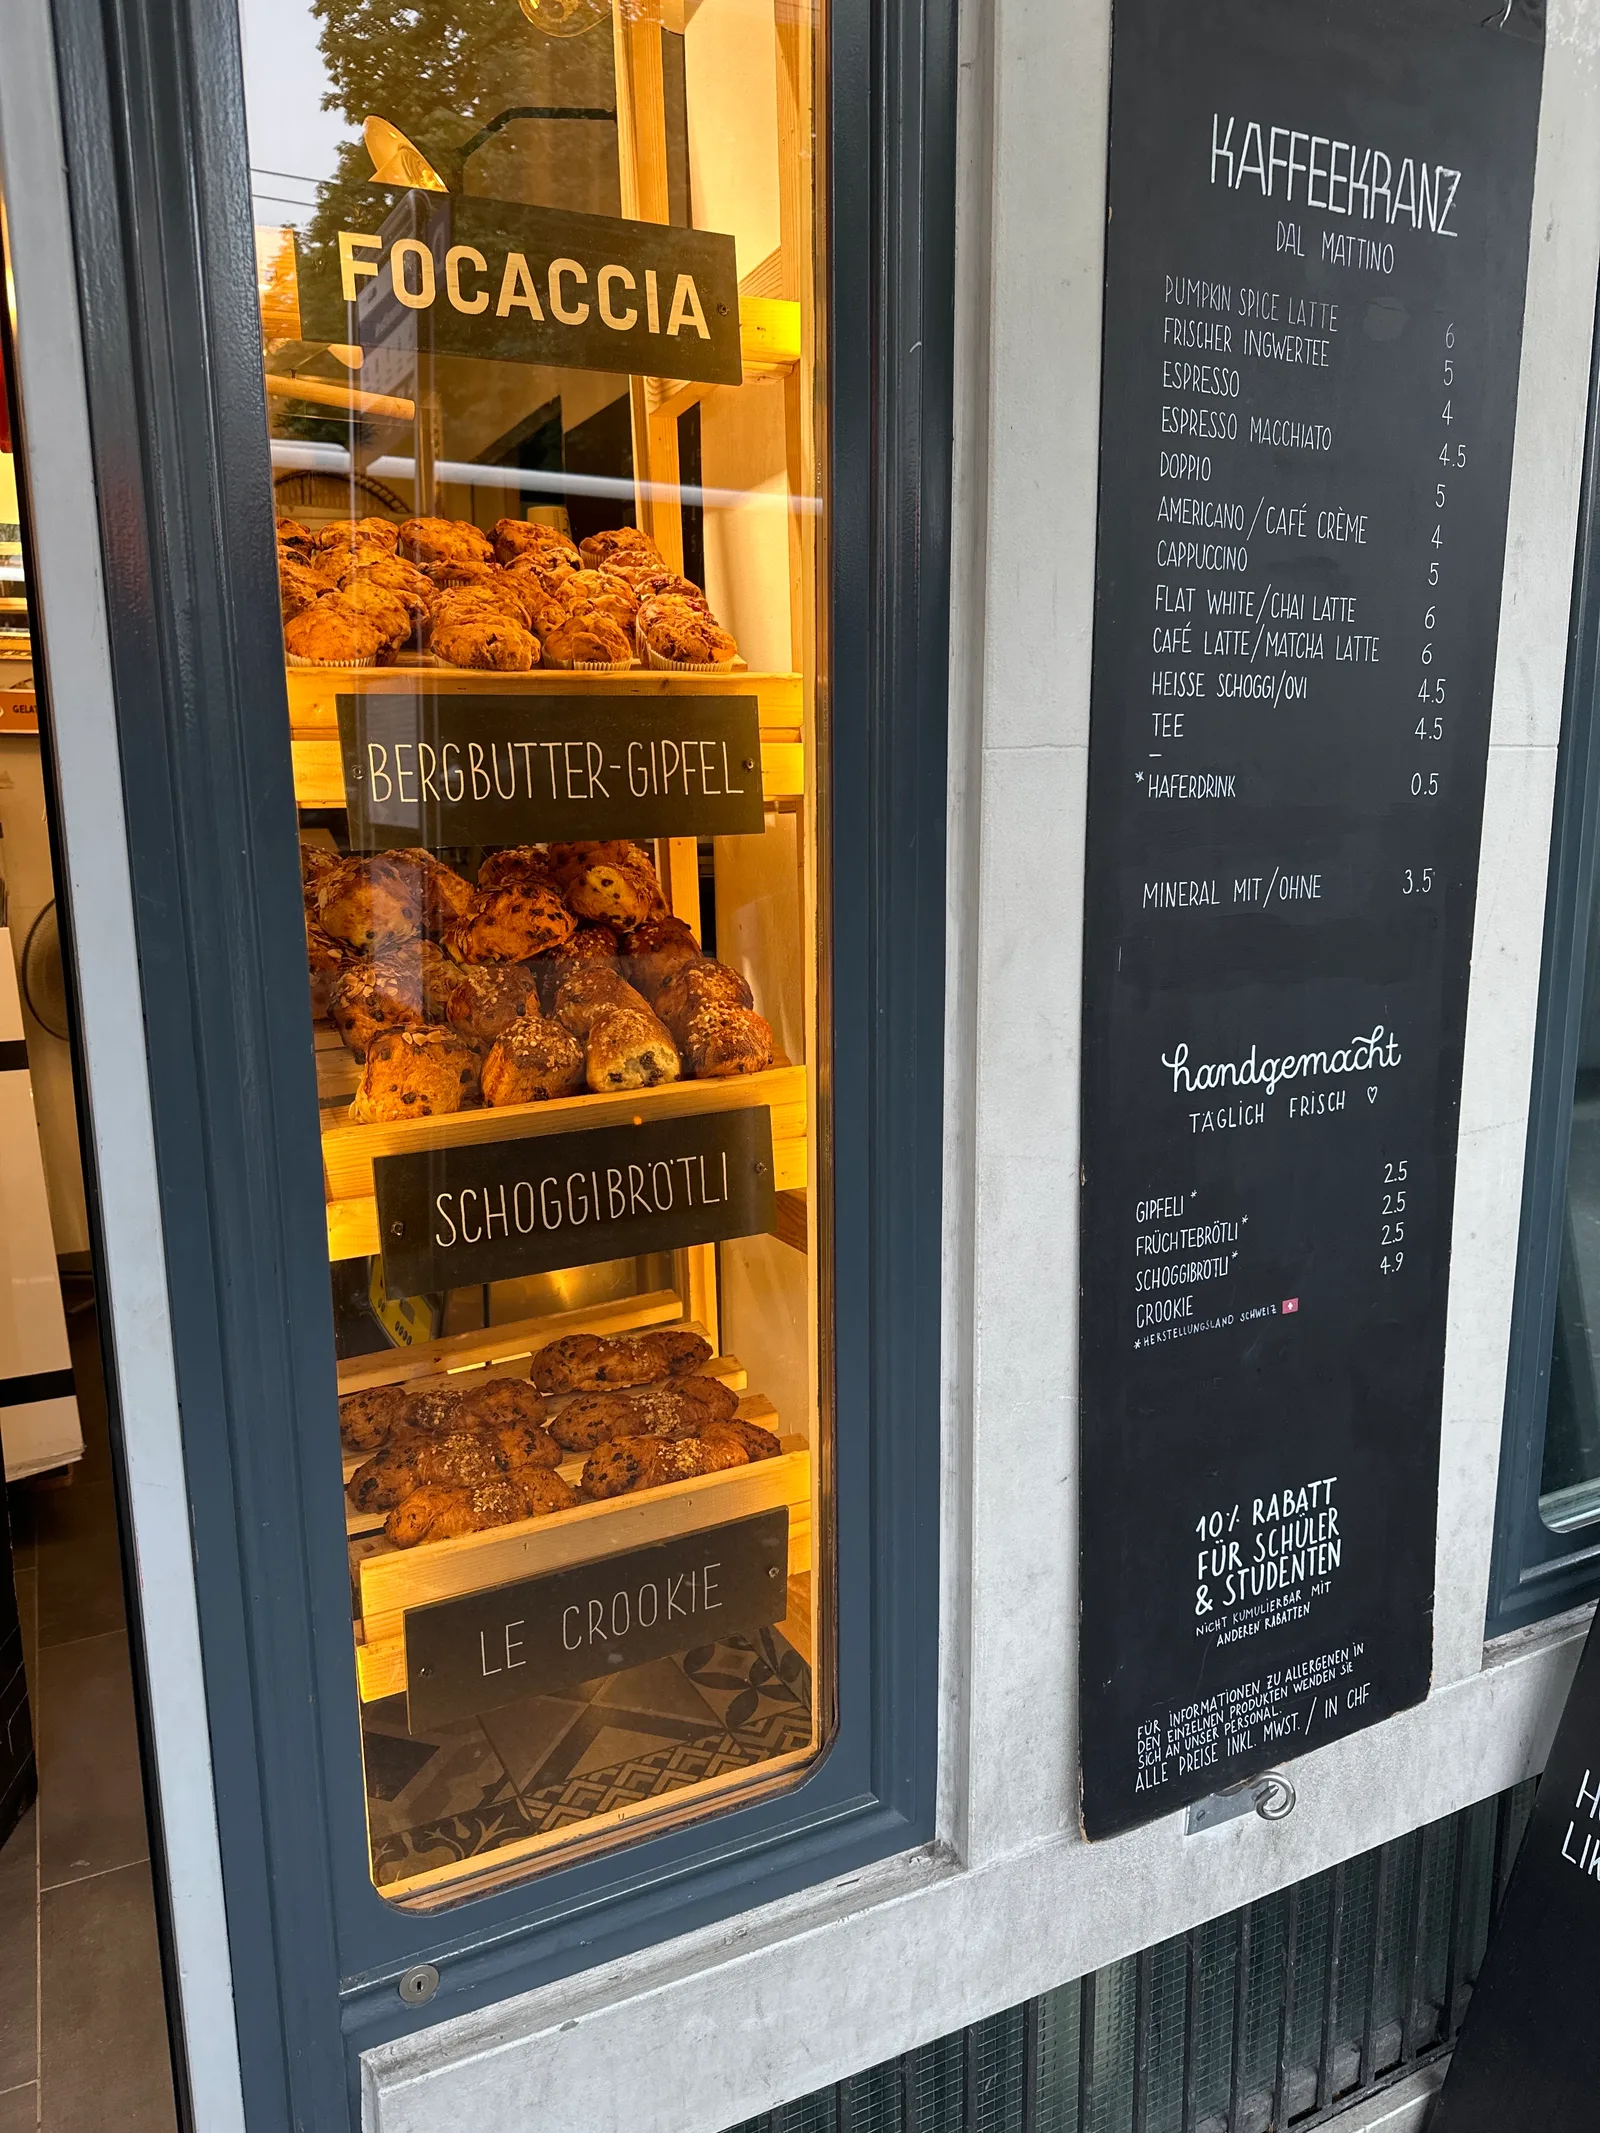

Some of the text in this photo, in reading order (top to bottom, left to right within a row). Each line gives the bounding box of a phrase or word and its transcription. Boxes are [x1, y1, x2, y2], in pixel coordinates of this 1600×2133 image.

[1210, 113, 1461, 237] KAFFEEKRANZ
[1276, 221, 1395, 274] DAL MATTINO
[337, 231, 711, 340] FOCACCIA
[1165, 275, 1455, 348] PUMPKIN SPICE LATTE 6
[1163, 317, 1453, 385] FRISCHER INGWERTEE 5
[1162, 360, 1453, 426] ESPRESSO 4
[1161, 406, 1467, 468] ESPRESSO MACCHIATO 4.5
[1160, 451, 1446, 508] DOPPIO 5
[1317, 506, 1368, 544] CRÈME
[1431, 524, 1443, 549] 4
[1157, 540, 1439, 586] CAPPUCCINO 5
[1155, 584, 1196, 613] FLAT
[1312, 596, 1356, 623] LATTE
[1424, 605, 1436, 629] 6
[1153, 621, 1192, 653] CAFÉ
[1336, 635, 1380, 662] LATTE
[1421, 643, 1433, 665] 6
[1152, 671, 1205, 697] HEISSE
[1417, 678, 1446, 704] 4.5
[1152, 712, 1443, 741] TEE 4.5
[367, 740, 745, 803] BERGBUTTER-GIPFEL
[1411, 772, 1439, 796] 0.5
[1142, 880, 1220, 909] MINERAL
[1402, 868, 1433, 895] 3.5
[1162, 1025, 1402, 1095] handgemacht
[1289, 1090, 1346, 1118] FRISCH
[435, 1151, 729, 1248] SCHOGGIBRÖTLI
[1382, 1191, 1406, 1215] 2.5
[1383, 1160, 1408, 1184] 2.5
[1381, 1222, 1405, 1245] 2.5
[1136, 1252, 1404, 1328] CROOKIE 4.9
[1195, 1477, 1337, 1542] 10% RABATT
[1198, 1507, 1340, 1580] FÜR SCHÜLER
[1195, 1539, 1342, 1616] & STUDENTEN
[480, 1562, 723, 1677] LE CROOKIE
[1216, 1602, 1311, 1647] ANDEREN RABATTEN
[1137, 1719, 1161, 1740] FÜR
[1267, 1671, 1281, 1690] ZU
[1285, 1648, 1349, 1683] ALLERGENEN
[1137, 1734, 1161, 1755] DEN
[1230, 1685, 1288, 1720] PRODUKTEN
[1293, 1668, 1336, 1694] WENDEN
[1135, 1761, 1168, 1793] ALLE
[1179, 1742, 1218, 1776] PREISE
[1227, 1730, 1257, 1757] INKL.
[1263, 1712, 1300, 1742] MWST.
[1325, 1695, 1338, 1719] IN
[1347, 1682, 1371, 1709] CHF
[1165, 1742, 1180, 1759] AN
[1184, 1727, 1219, 1751] UNSER
[1224, 1705, 1282, 1736] PERSONAL.
